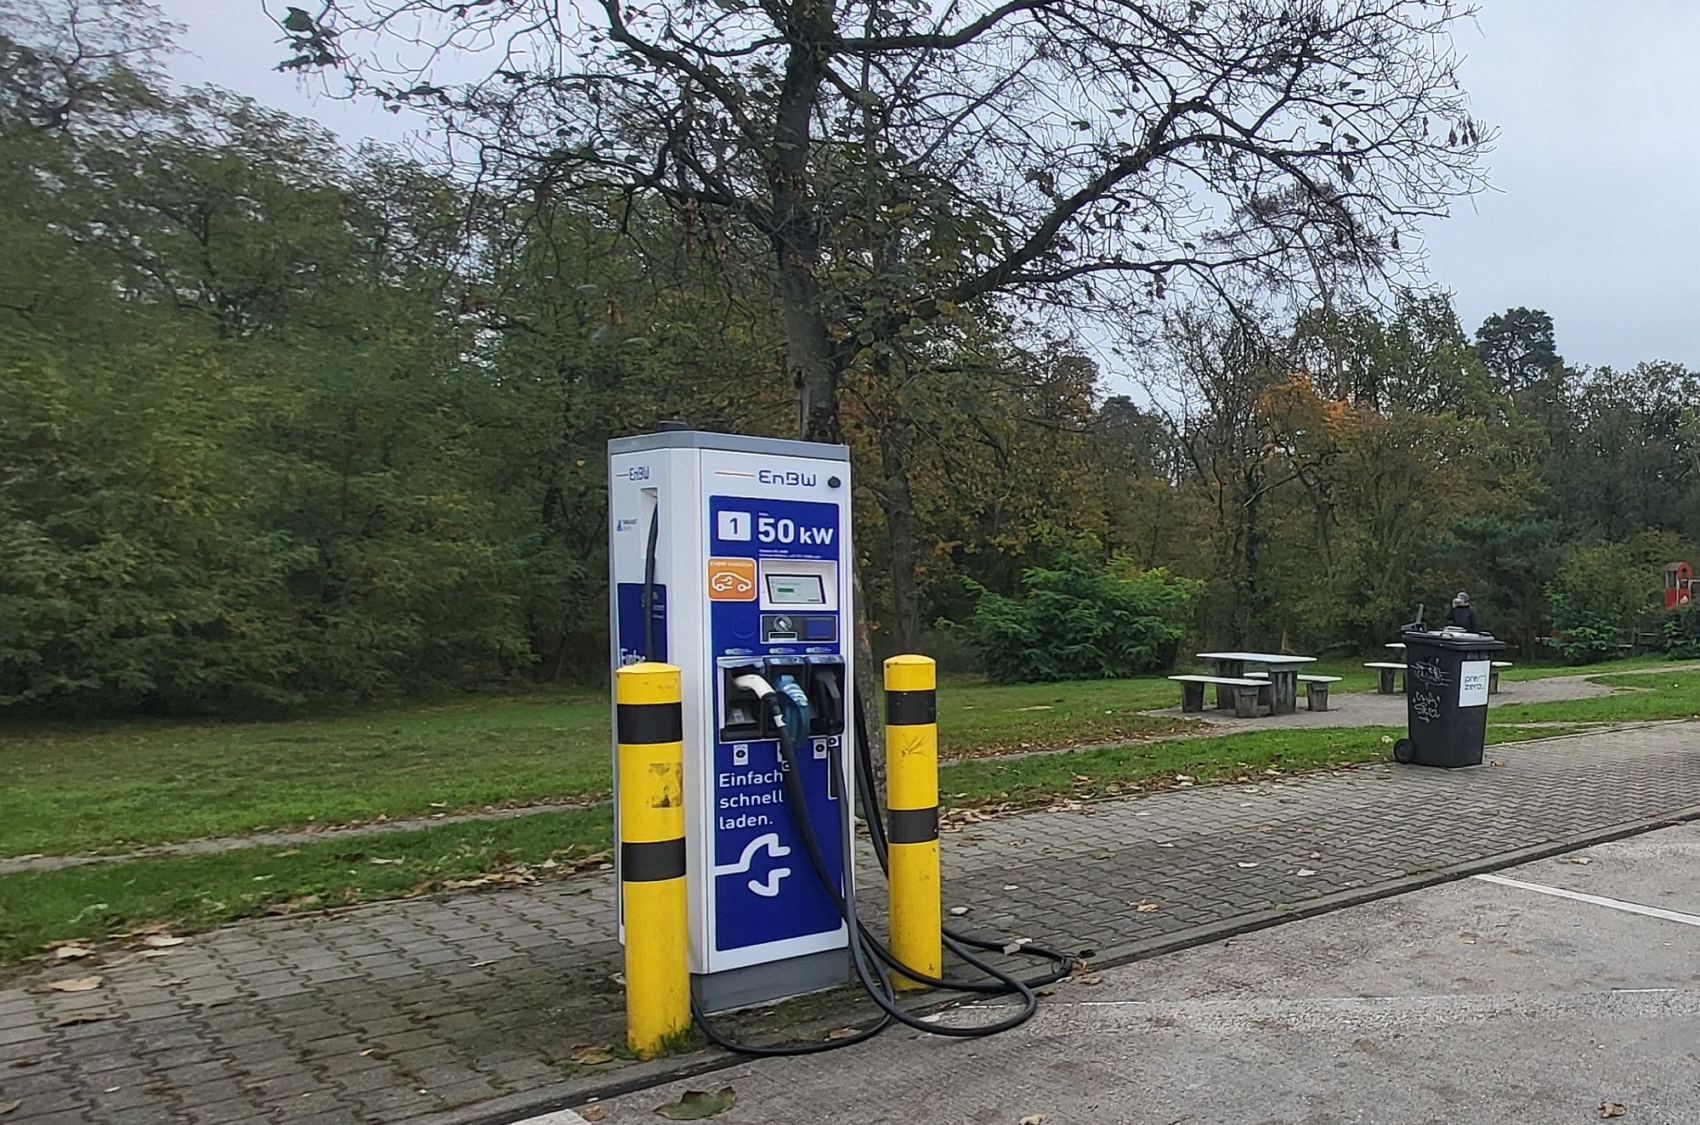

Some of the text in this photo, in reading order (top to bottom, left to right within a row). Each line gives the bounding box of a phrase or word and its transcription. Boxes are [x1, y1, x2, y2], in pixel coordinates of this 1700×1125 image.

[629, 465, 650, 481] EnBW
[758, 469, 816, 487] EnBW
[729, 517, 834, 545] 1 50 kW
[719, 769, 783, 788] Einfach
[719, 789, 784, 809] schnell
[719, 813, 774, 830] laden.
